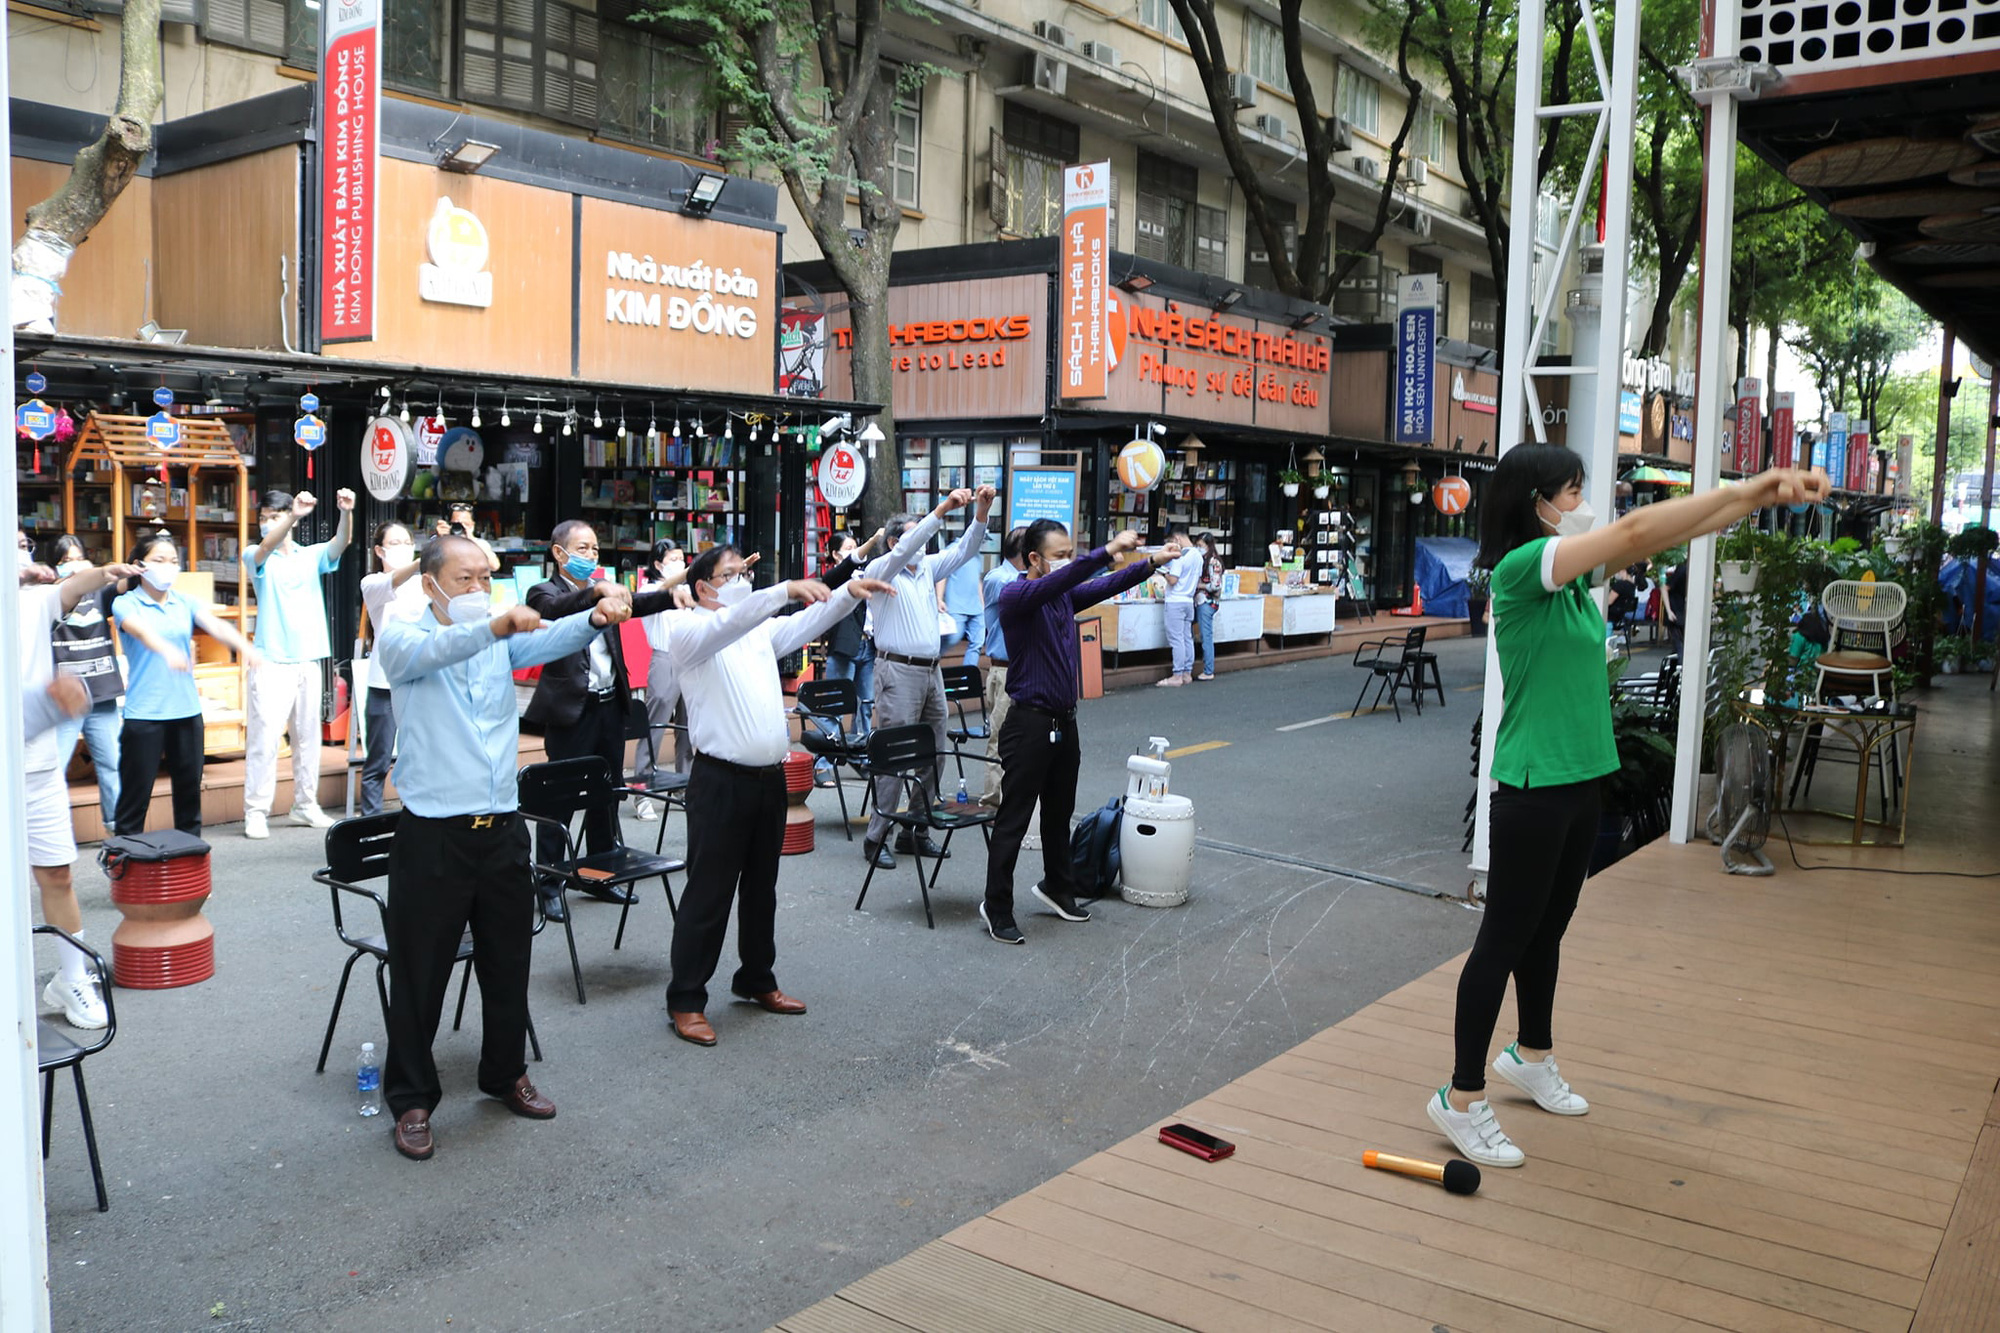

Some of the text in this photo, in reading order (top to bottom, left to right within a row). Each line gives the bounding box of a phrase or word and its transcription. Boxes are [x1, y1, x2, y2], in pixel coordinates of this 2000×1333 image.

[336, 120, 348, 161] KIM
[333, 167, 348, 210] BẢN
[350, 45, 365, 324] KIM DONG PUBLISHING HOUSE
[332, 216, 346, 272] XUẤT
[607, 250, 758, 299] Nhà xuất bản
[332, 278, 346, 326] NHÀ
[606, 288, 661, 328] KIM
[667, 292, 757, 339] ĐỒNG
[1068, 222, 1084, 387] SÁCH THÁI HÀ
[1090, 238, 1100, 366] THAIHABOOKS
[918, 351, 944, 372] to
[948, 346, 1006, 370] Lead
[1130, 302, 1330, 374] NHÀ SÁCH THÁI HÀ
[1139, 354, 1198, 397] Phụng
[1206, 370, 1228, 402] sự
[1232, 363, 1252, 398] để
[1404, 314, 1416, 434] ĐẠI HỌC HOA SEN
[1416, 314, 1426, 434] HOA SEN UNIVERSITY
